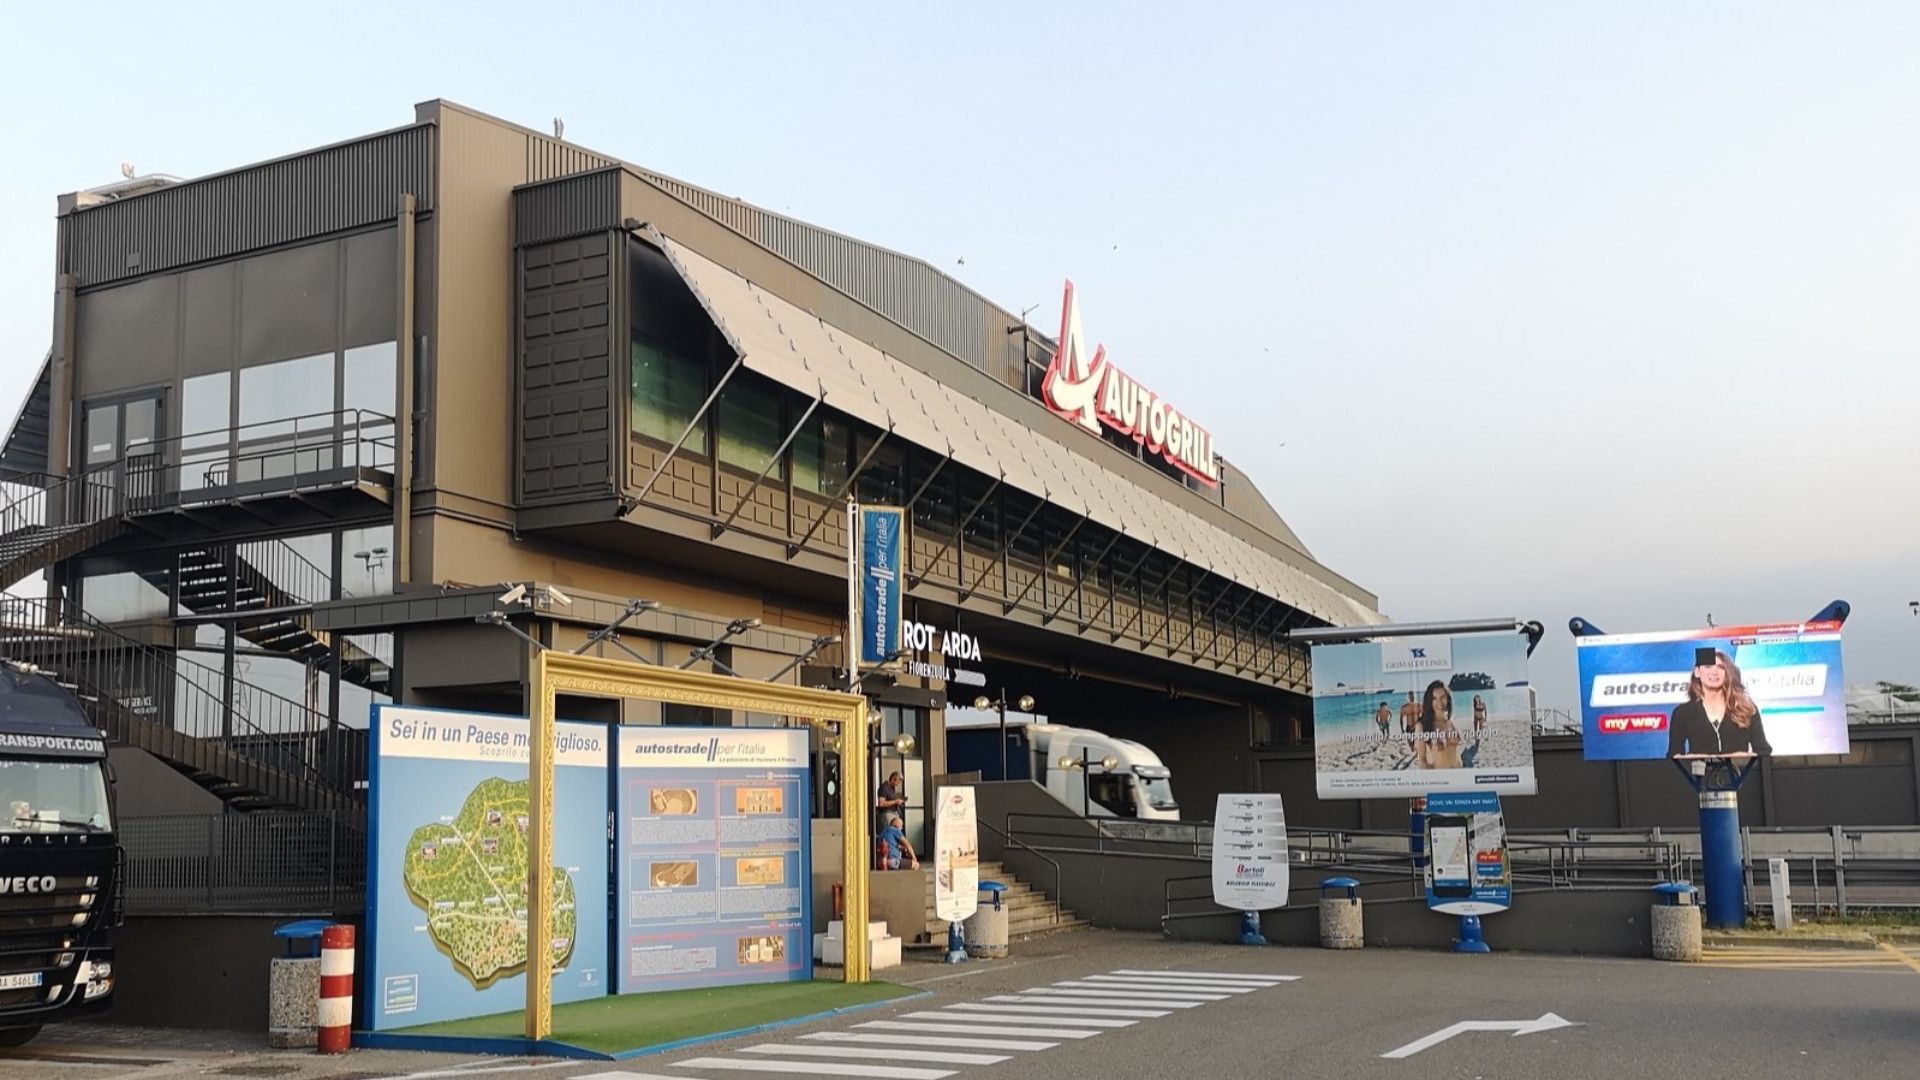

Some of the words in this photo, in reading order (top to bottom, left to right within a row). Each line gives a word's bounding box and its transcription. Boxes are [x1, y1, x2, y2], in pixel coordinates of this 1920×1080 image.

[1103, 366, 1217, 482] AUTOGRILL
[876, 516, 888, 549] l'italia
[877, 550, 889, 569] per
[876, 579, 888, 657] autostrade
[903, 620, 936, 652] ROT
[941, 629, 982, 662] ARDA
[908, 660, 950, 681] FIORENZUOLA
[1603, 679, 1690, 696] autostra
[390, 719, 417, 740] Sei
[421, 722, 437, 741] in
[442, 728, 462, 743] un
[466, 725, 509, 746] Paese
[1605, 716, 1629, 731] my
[1630, 715, 1662, 729] way
[480, 745, 517, 758] Scoprilo
[635, 743, 707, 755] autostrade
[716, 745, 736, 757] per
[737, 743, 766, 755] l'italia
